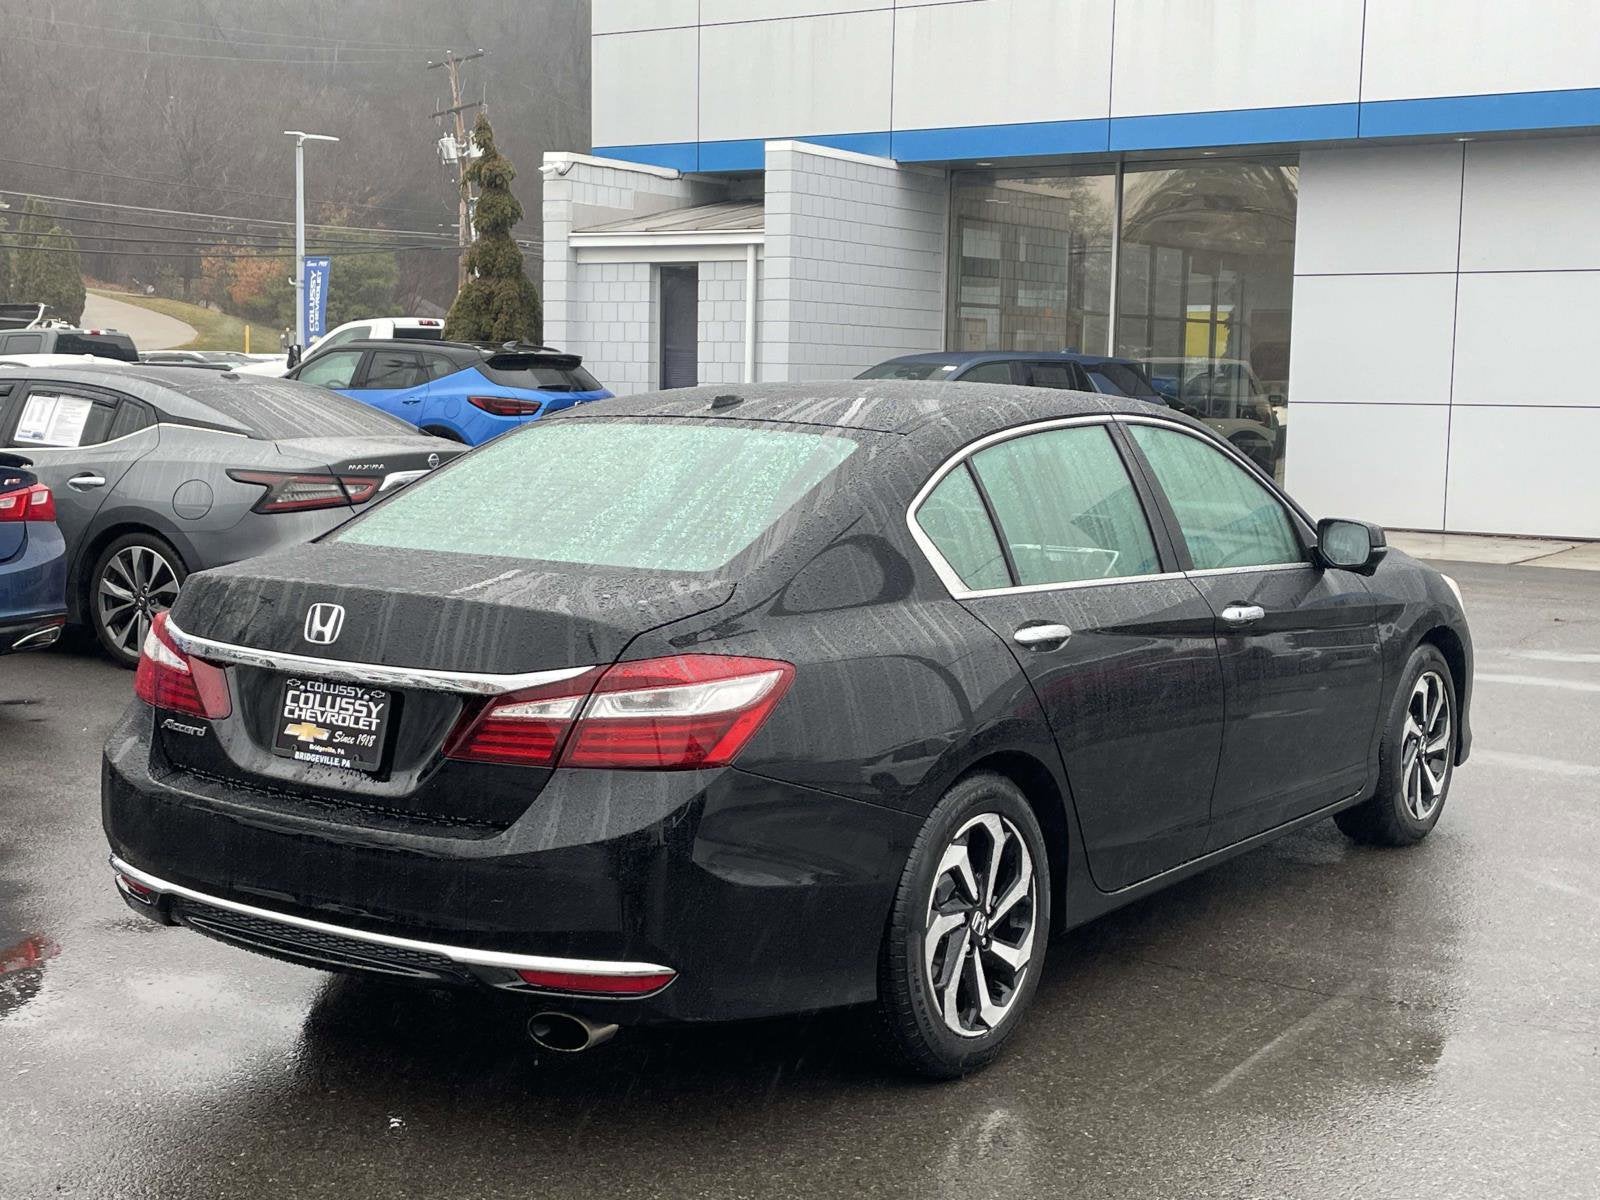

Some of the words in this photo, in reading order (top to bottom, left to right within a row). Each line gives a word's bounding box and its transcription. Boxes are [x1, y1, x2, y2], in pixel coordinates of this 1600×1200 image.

[309, 270, 317, 332] COLUSSY
[314, 270, 322, 332] CHEVROLET
[348, 463, 385, 471] MAXIMA
[306, 680, 366, 698] COLUSSY
[285, 689, 385, 719] COLUSSY
[160, 718, 208, 737] Accord
[283, 705, 381, 731] CHEVROLET
[332, 730, 355, 745] Since
[356, 733, 376, 747] 1918
[341, 758, 351, 768] PA
